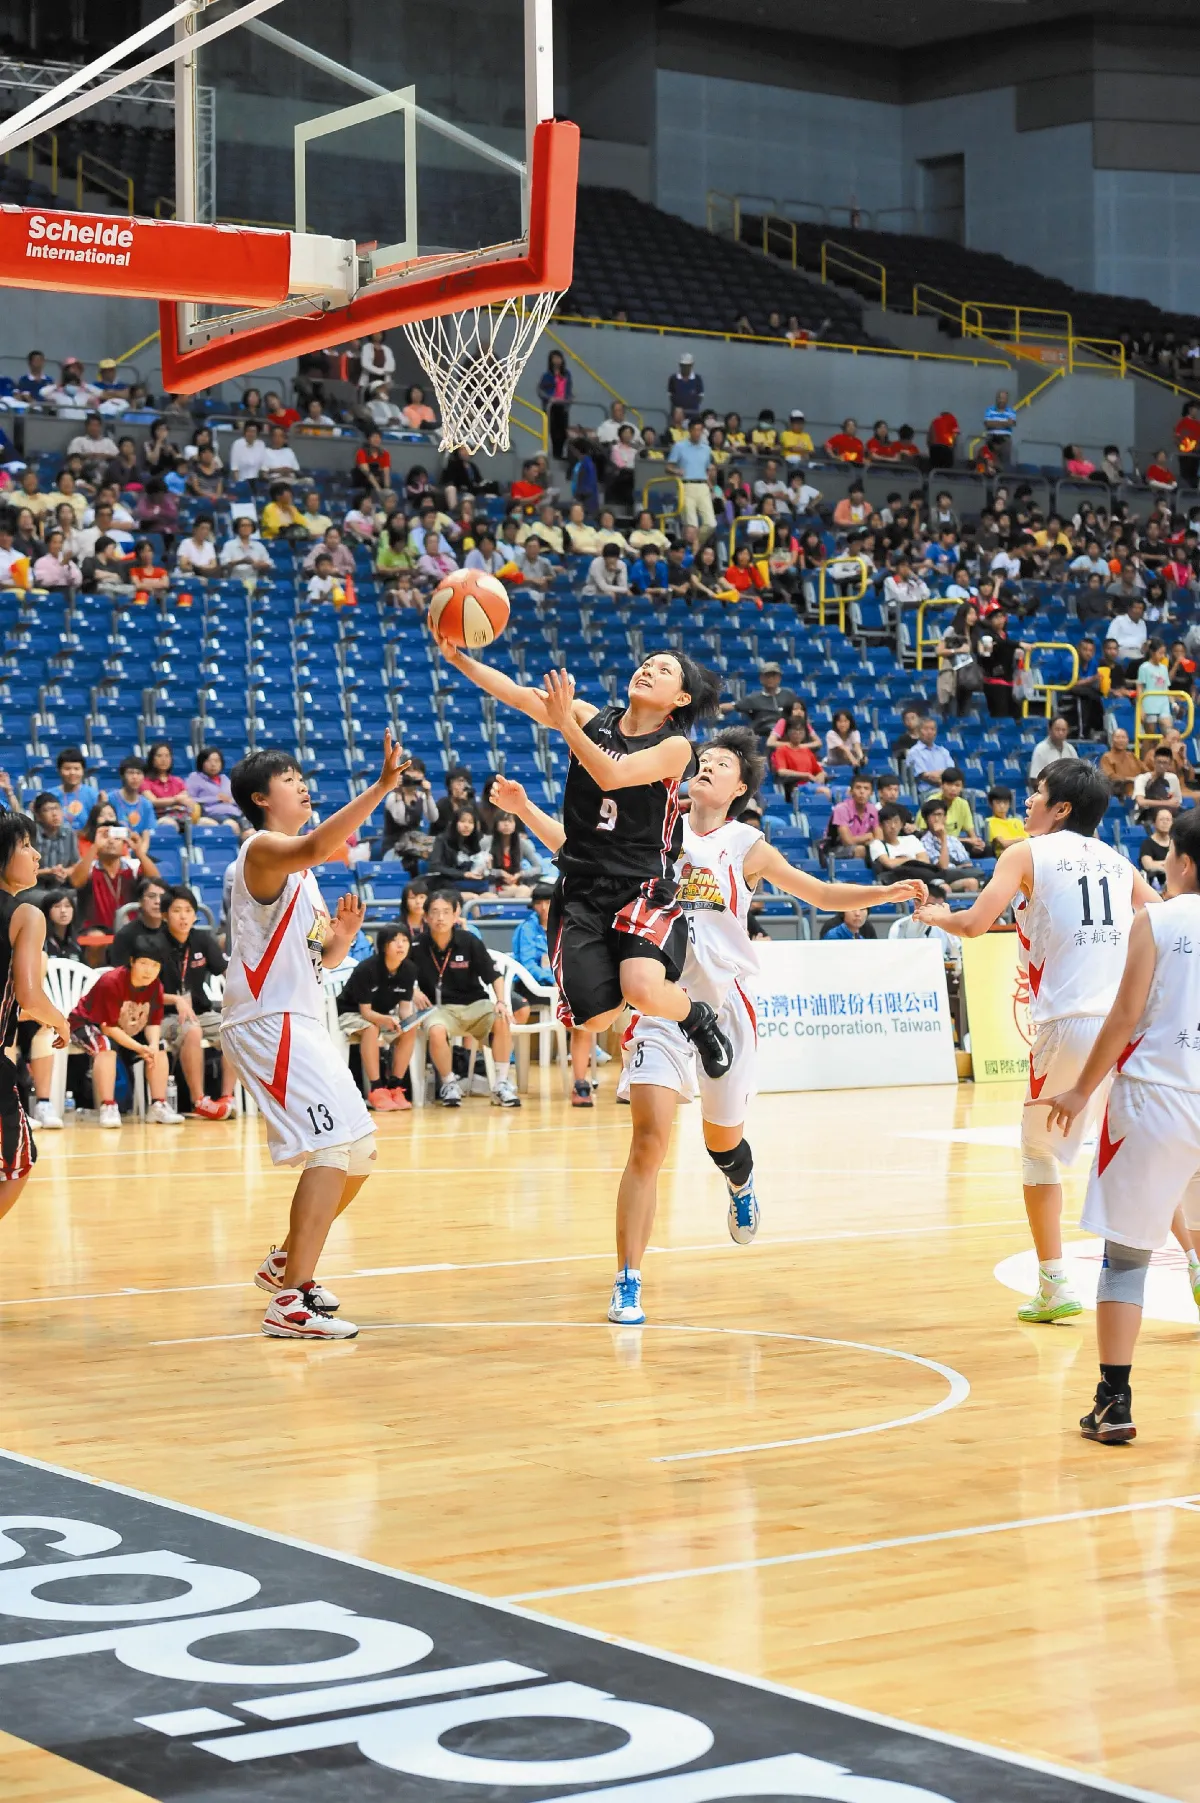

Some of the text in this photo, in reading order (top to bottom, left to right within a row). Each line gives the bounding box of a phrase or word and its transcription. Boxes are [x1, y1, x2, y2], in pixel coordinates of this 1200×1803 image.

[29, 215, 134, 248] Schelde
[26, 242, 131, 266] International
[596, 798, 618, 831] 9
[1078, 875, 1114, 926] 11
[687, 915, 696, 945] 5
[1073, 929, 1122, 946] 宗航宇
[756, 991, 940, 1018] 台灣中油股份有限公司
[757, 1017, 941, 1040] CPC Corporation, Taiwan
[306, 1103, 335, 1136] 13
